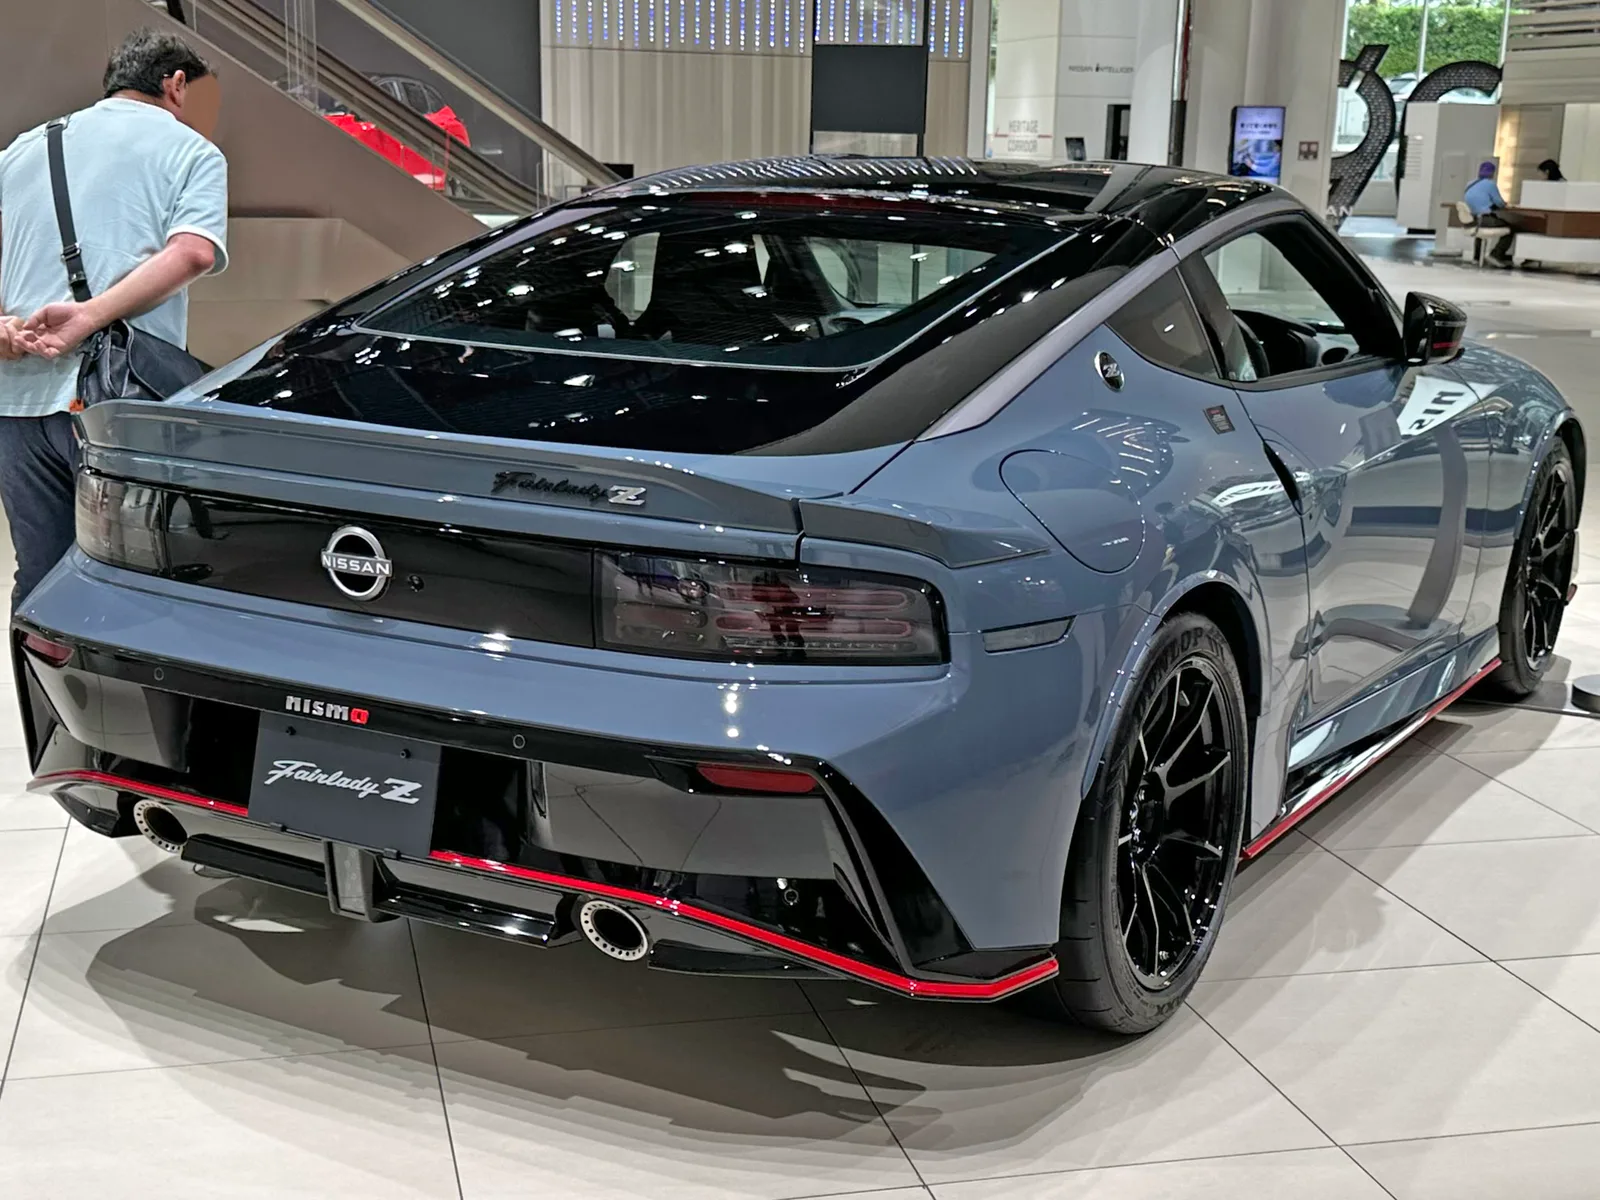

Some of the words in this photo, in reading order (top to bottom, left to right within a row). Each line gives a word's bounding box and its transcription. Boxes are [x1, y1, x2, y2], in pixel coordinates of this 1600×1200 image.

[609, 485, 647, 506] Z
[322, 554, 389, 575] NISSAN
[264, 760, 380, 798] Fairlady
[380, 778, 422, 804] Z
